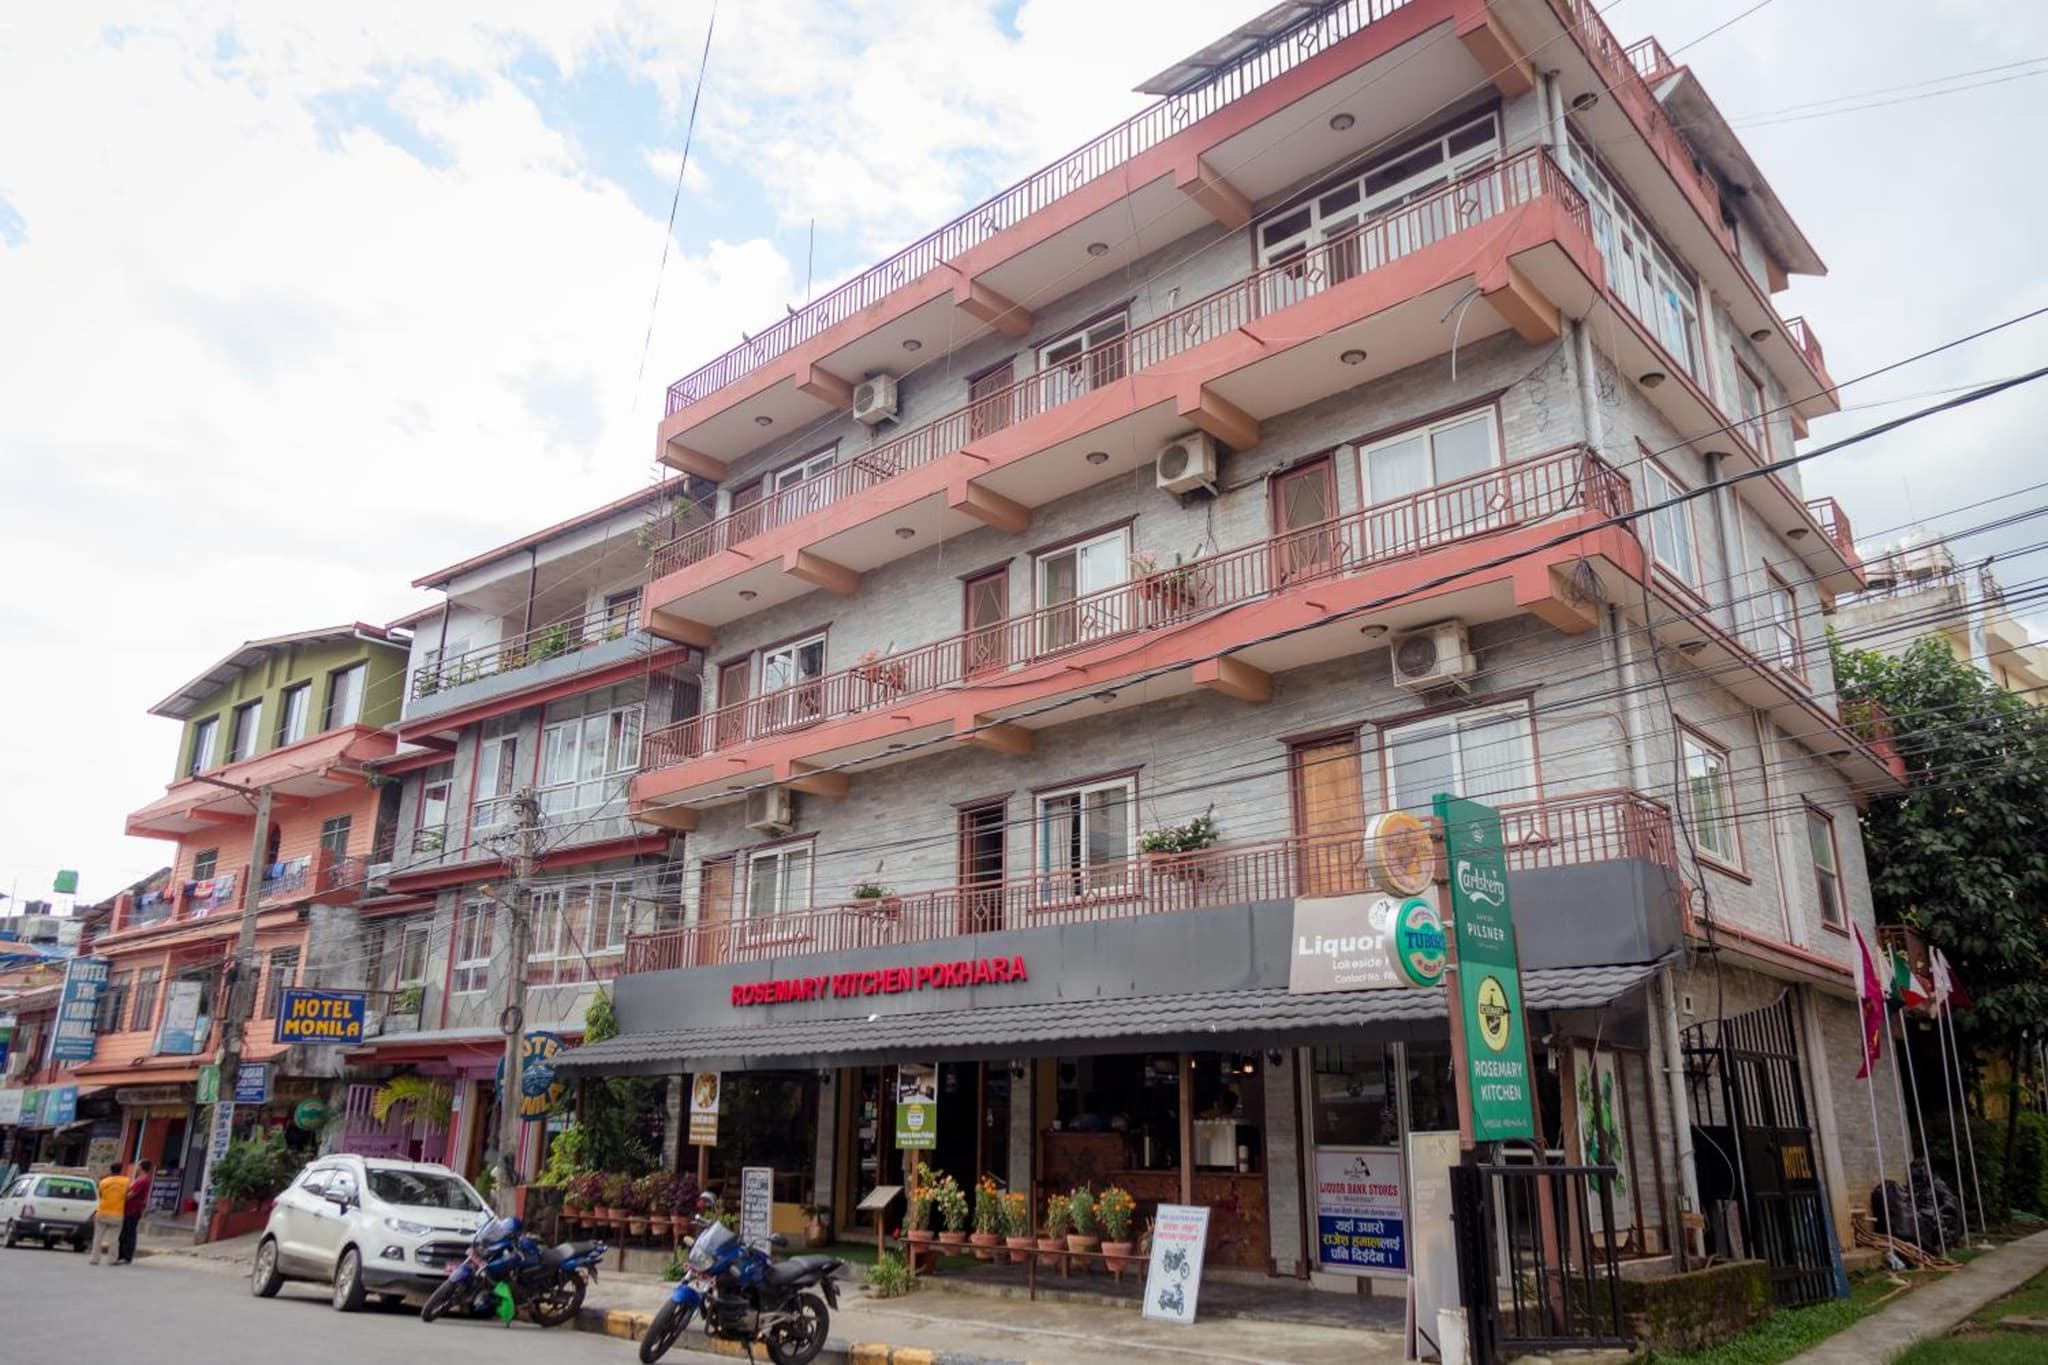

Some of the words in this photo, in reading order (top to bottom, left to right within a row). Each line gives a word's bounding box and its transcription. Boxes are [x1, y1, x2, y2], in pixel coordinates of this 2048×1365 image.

[1458, 861, 1504, 906] Carlsberg
[1467, 922, 1505, 941] PILSNER
[1299, 935, 1384, 958] Liquor
[731, 976, 828, 1007] ROSEMARY
[832, 966, 914, 998] KITCHEN
[916, 955, 1027, 991] POKHARA
[293, 999, 352, 1018] HOTEL
[284, 1020, 359, 1037] MONILA
[1474, 1060, 1522, 1078] ROSEMARY
[1480, 1084, 1522, 1101] KITCHEN
[1782, 1146, 1811, 1179] HOTEL
